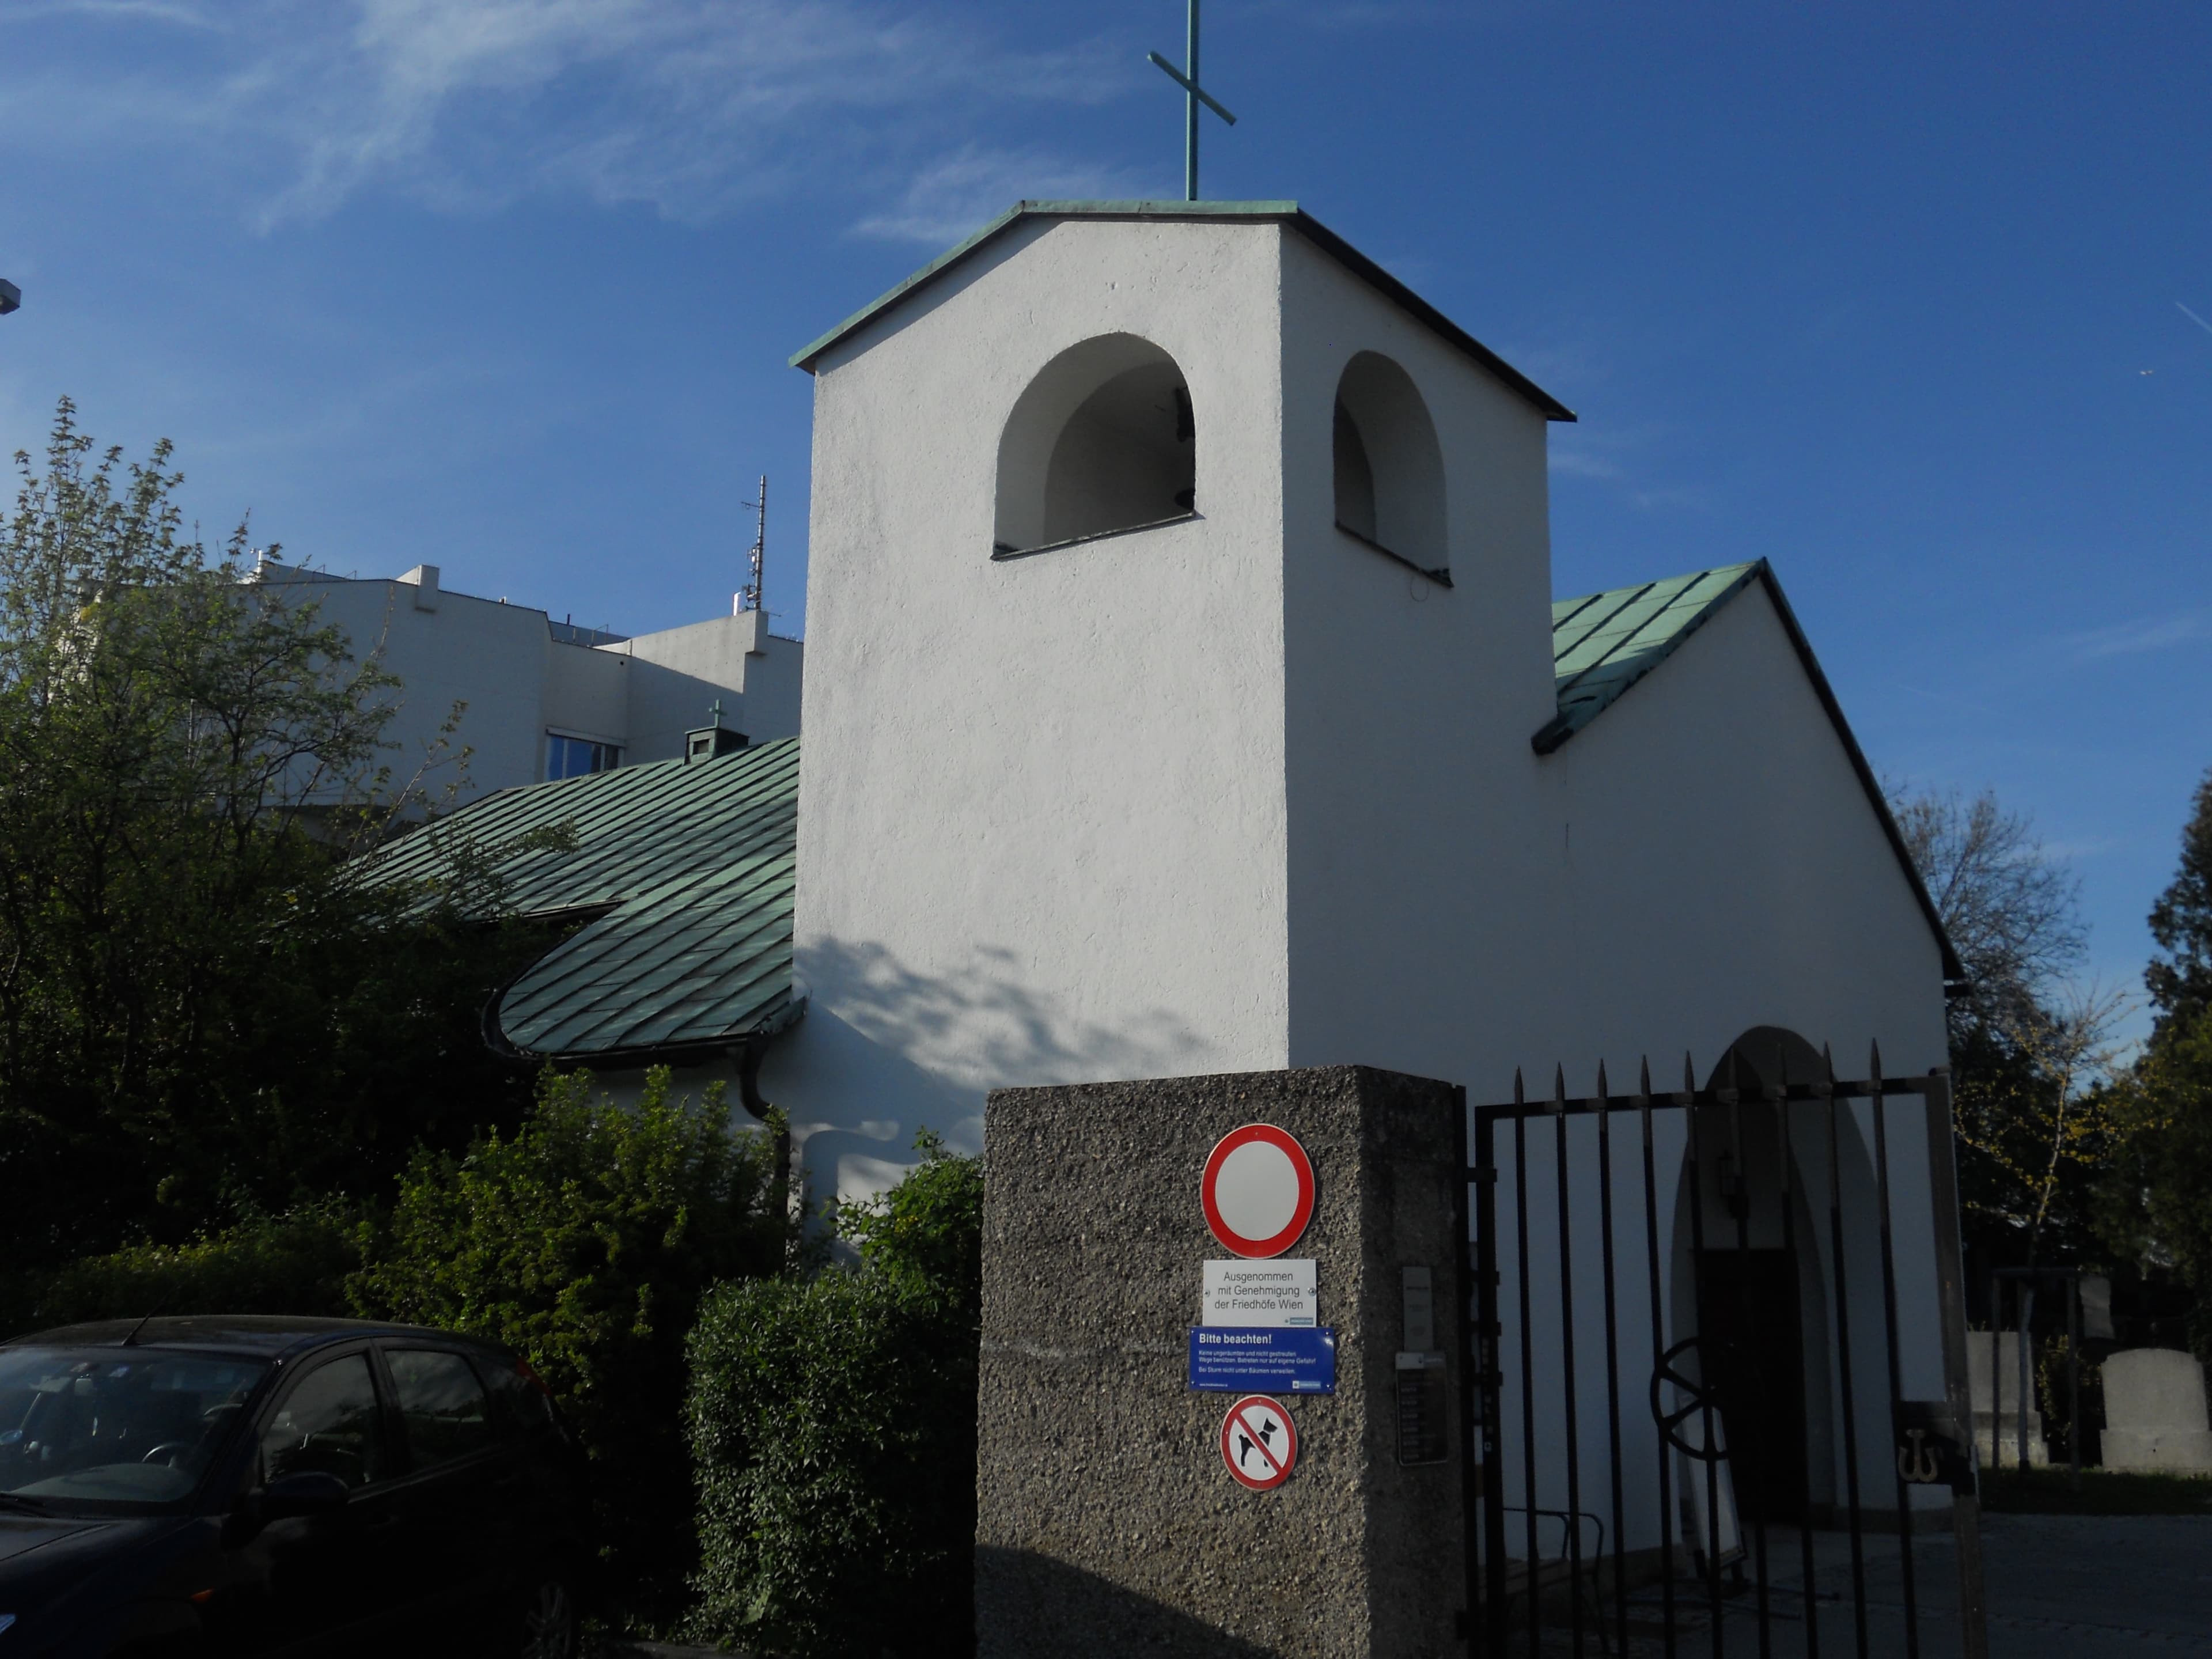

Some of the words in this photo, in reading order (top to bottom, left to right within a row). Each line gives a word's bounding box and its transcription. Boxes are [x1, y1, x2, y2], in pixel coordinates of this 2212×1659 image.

[1224, 1272, 1293, 1283] Ausgenommen
[1218, 1286, 1232, 1295] mit
[1234, 1285, 1300, 1297] Genehmigung
[1214, 1300, 1229, 1309] der
[1232, 1299, 1275, 1309] Friedhöfe
[1279, 1299, 1303, 1309] Wien
[1199, 1334, 1221, 1343] Bitte
[1224, 1334, 1271, 1344] beachten!
